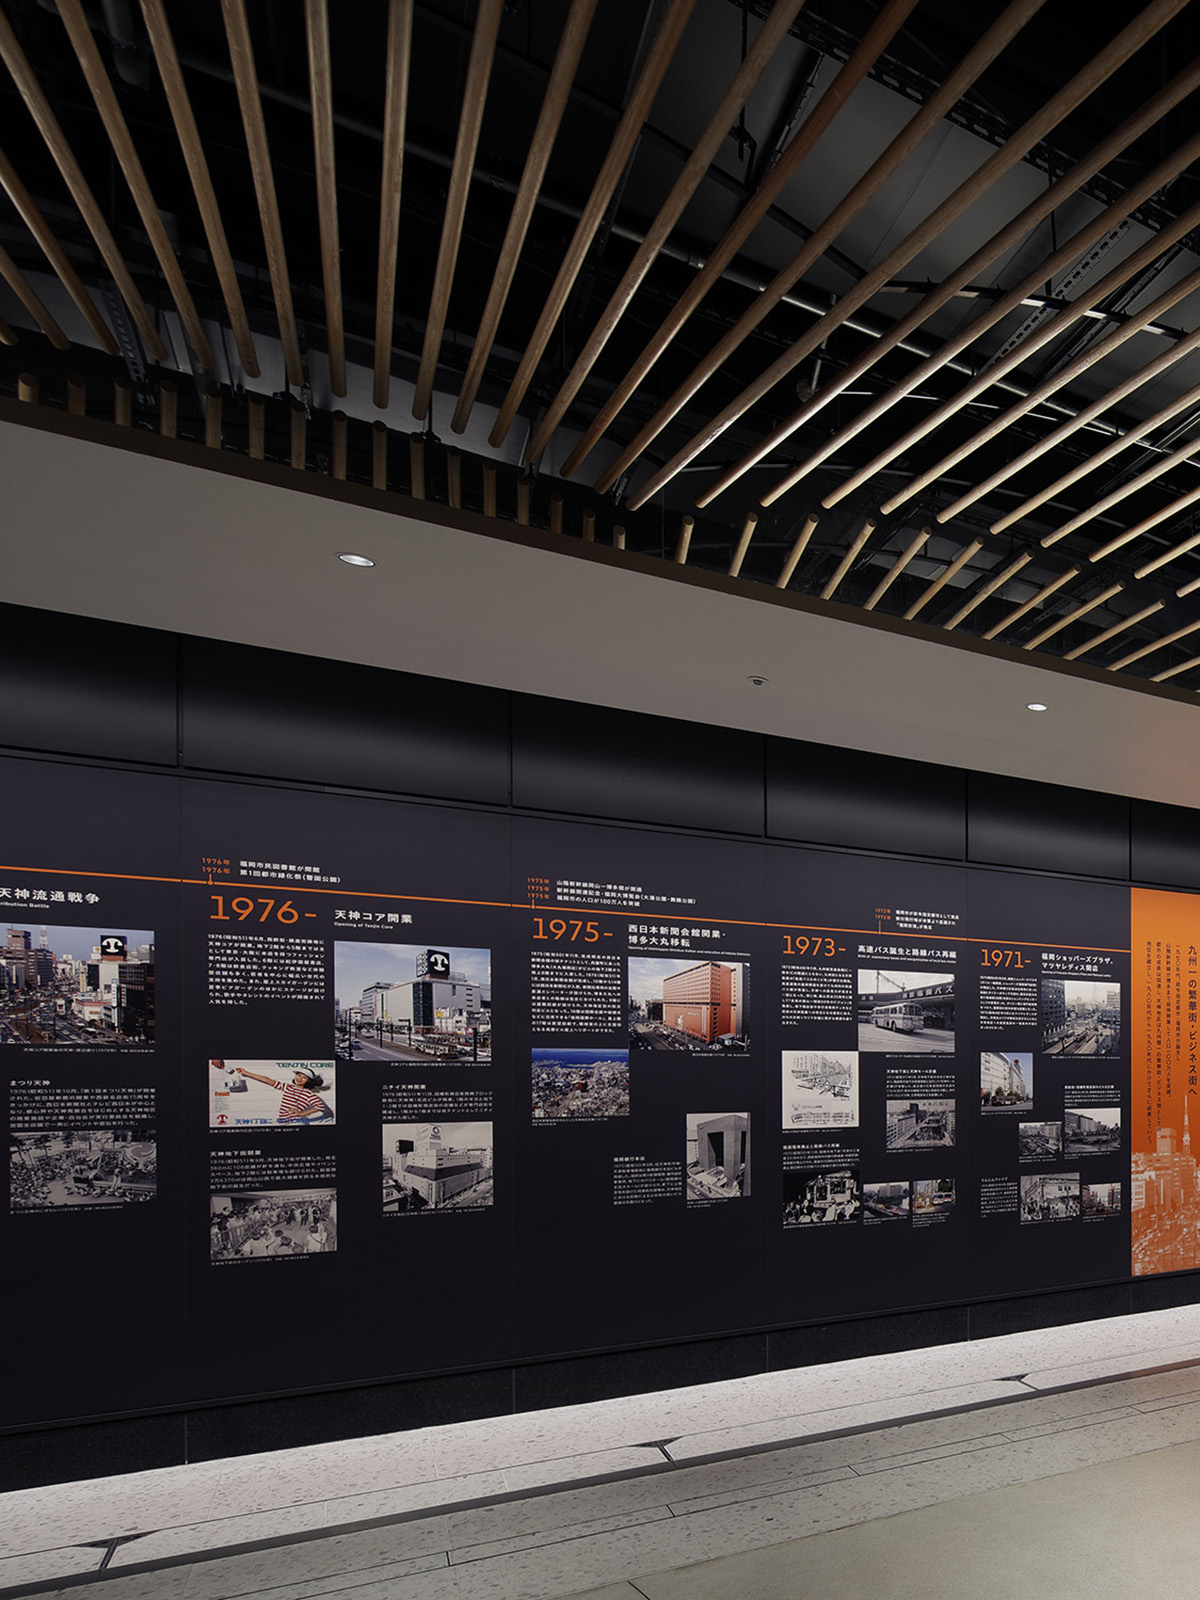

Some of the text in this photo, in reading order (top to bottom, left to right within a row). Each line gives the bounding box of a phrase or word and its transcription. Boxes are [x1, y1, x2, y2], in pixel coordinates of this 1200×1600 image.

[0, 887, 100, 904] 天神流通戦争
[210, 895, 317, 924] 1976-
[334, 909, 413, 925] 天神コア開業
[334, 921, 357, 929] Opening
[533, 918, 613, 942] 1975-
[628, 935, 690, 947] 博多大丸移転
[783, 935, 846, 957] 1973-
[981, 949, 1031, 968] 1971-
[1188, 944, 1197, 1095] 九州一の繁華街・ビジネス街へ
